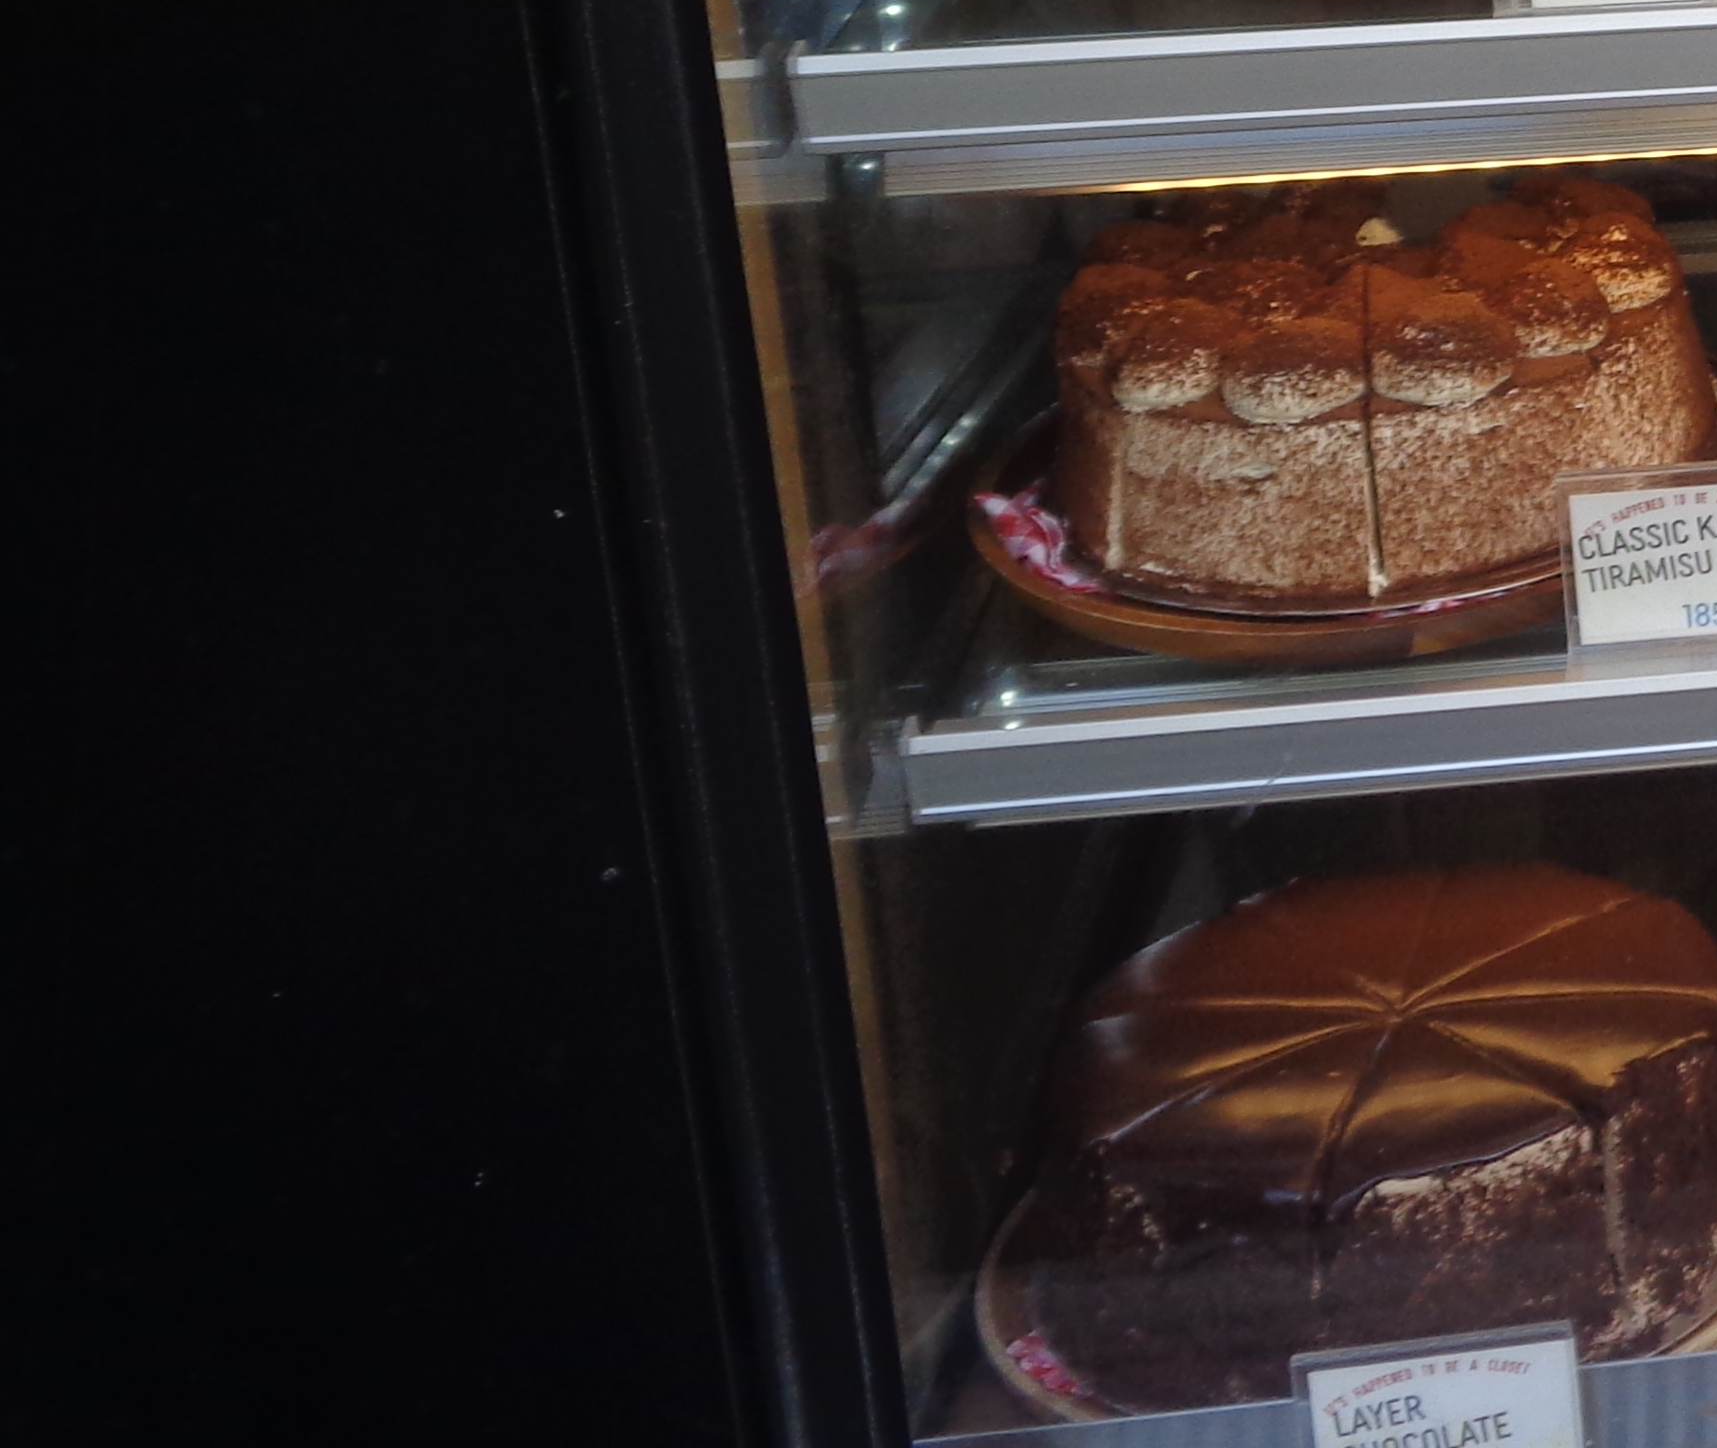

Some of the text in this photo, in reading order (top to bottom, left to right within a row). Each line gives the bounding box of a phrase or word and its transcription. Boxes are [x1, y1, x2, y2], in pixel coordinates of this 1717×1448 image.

[1579, 520, 1688, 561] CLASSIC
[1582, 550, 1713, 593] TIRAMISU
[1334, 1395, 1426, 1438] LAYER
[1342, 1412, 1512, 1448] COLATE
